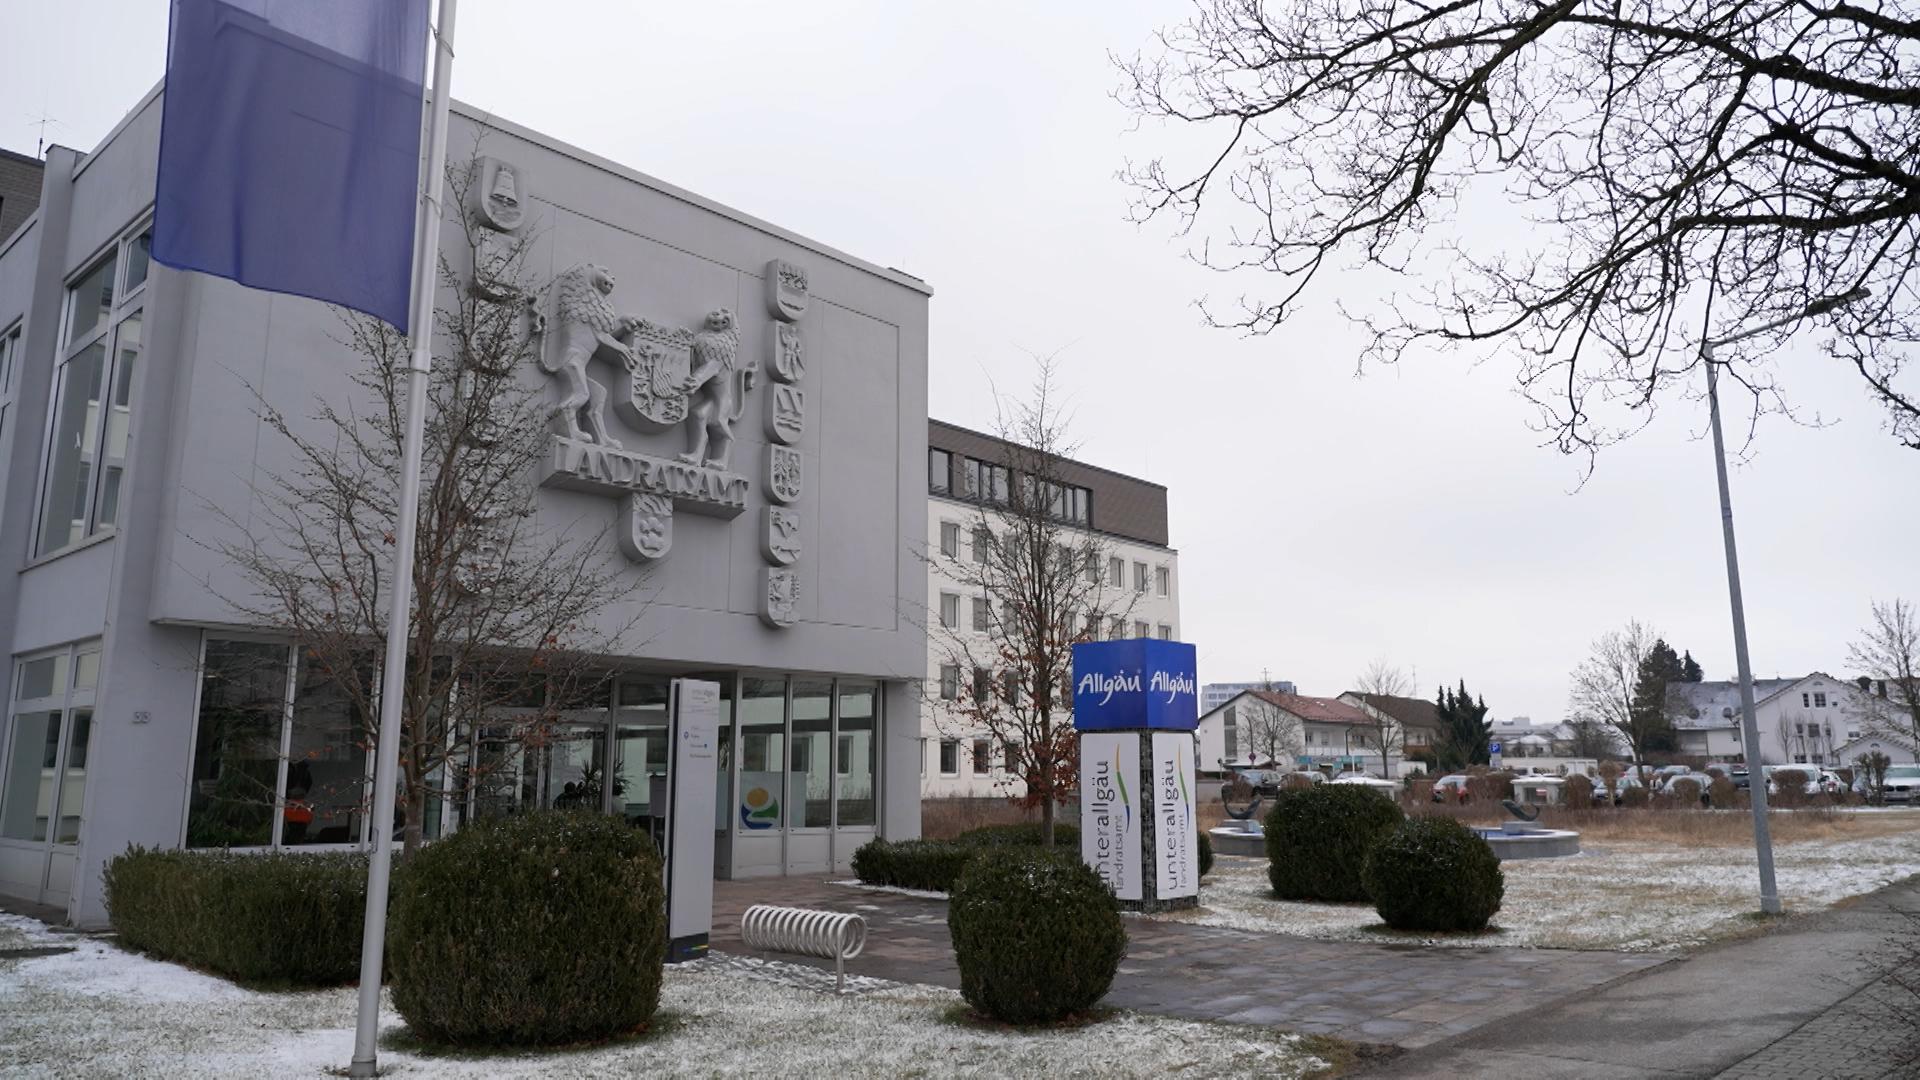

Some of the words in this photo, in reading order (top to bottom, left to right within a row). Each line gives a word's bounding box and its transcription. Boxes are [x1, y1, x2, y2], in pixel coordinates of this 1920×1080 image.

[554, 441, 749, 506] LANDRATSAMT
[1078, 669, 1141, 706] Allgäu
[1150, 671, 1195, 704] Allgäu
[1162, 760, 1179, 890] unterallgäu
